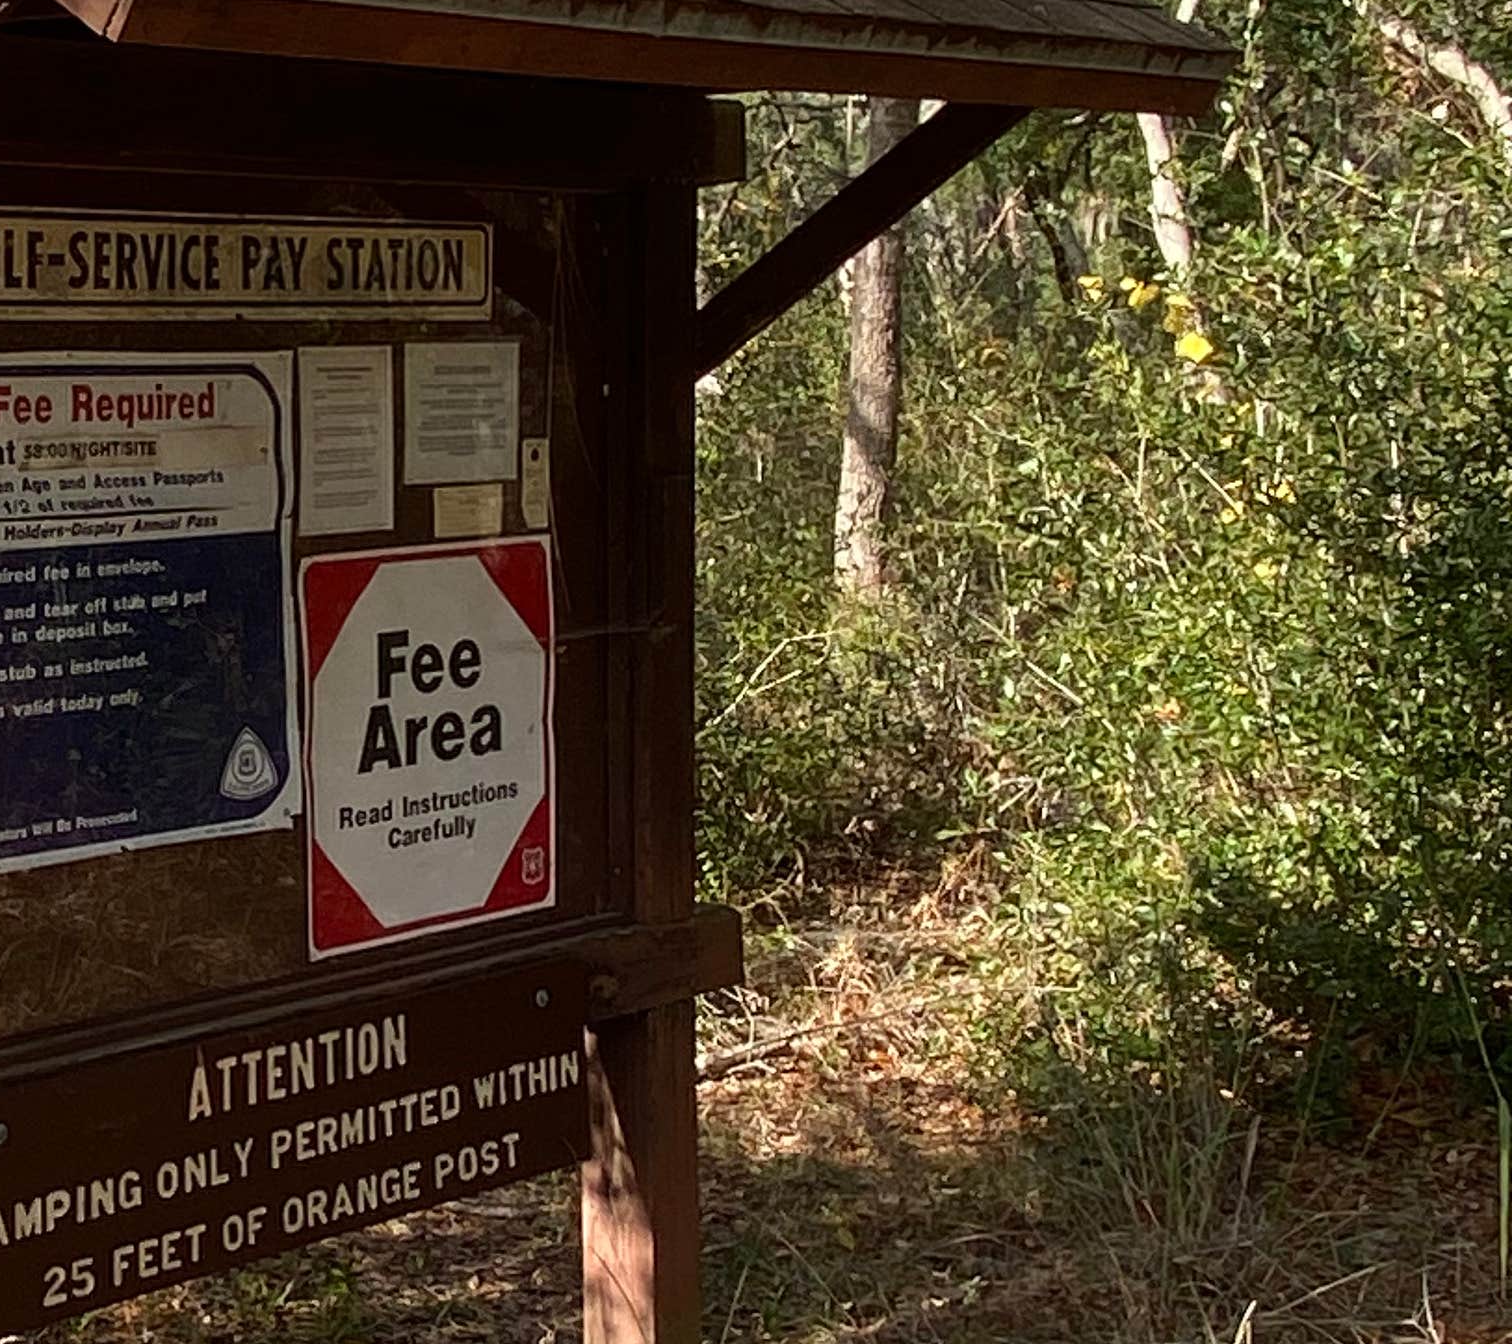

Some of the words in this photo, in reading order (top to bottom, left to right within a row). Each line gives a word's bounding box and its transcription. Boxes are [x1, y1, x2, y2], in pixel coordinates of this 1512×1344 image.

[241, 235, 309, 292] PAY
[326, 237, 464, 293] STATION
[71, 381, 216, 428] Required
[21, 476, 51, 494] Age
[58, 475, 86, 491] and
[93, 473, 147, 489] Access
[153, 469, 225, 487] Passports
[38, 499, 54, 513] of
[60, 494, 123, 513] required
[131, 516, 183, 533] Annual
[185, 513, 219, 529] Pass
[43, 565, 70, 581] fee
[76, 561, 92, 579] in
[3, 603, 37, 621] and
[43, 602, 79, 618] tear
[84, 596, 107, 615] off
[113, 594, 147, 612] stub
[151, 590, 179, 608] and
[183, 589, 207, 608] put
[11, 626, 29, 644] in
[35, 621, 96, 643] deposit
[43, 663, 64, 678] as
[376, 628, 482, 700] Fee
[12, 699, 55, 718] valid
[60, 693, 104, 712] today
[357, 703, 503, 775] Area
[338, 799, 393, 830] Read
[402, 781, 519, 817] Instructions
[388, 814, 477, 849] Carefully
[188, 1012, 408, 1122] ATTENTION
[156, 1136, 255, 1200] ONLY
[270, 1082, 461, 1169] PERMITTED
[473, 1050, 580, 1112] WITHIN
[42, 1256, 95, 1308] 25
[112, 1222, 207, 1287] FEET
[222, 1205, 268, 1252] OF
[283, 1161, 423, 1234] ORANGE
[434, 1132, 521, 1190] POST
